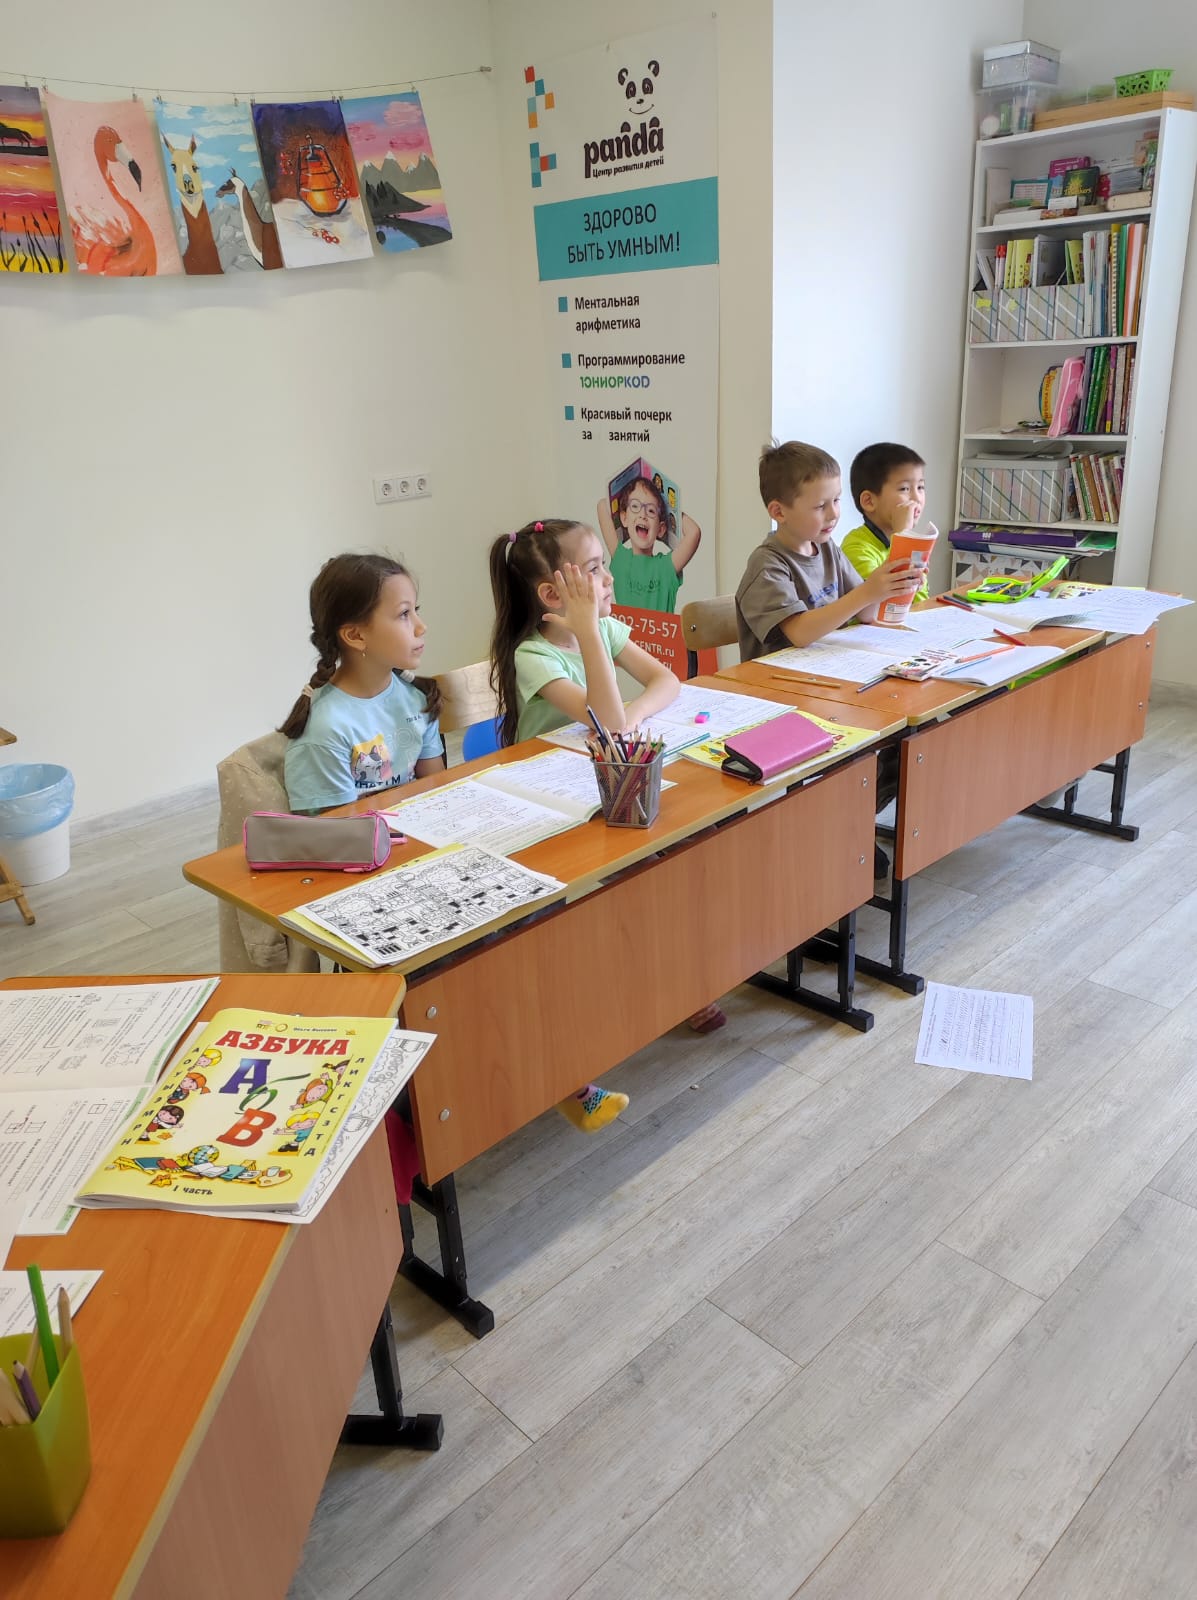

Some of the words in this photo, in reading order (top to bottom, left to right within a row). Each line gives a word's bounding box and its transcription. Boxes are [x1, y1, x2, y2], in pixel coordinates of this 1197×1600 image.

[584, 117, 664, 178] panda
[593, 168, 612, 178] Центр
[614, 162, 643, 176] развития
[645, 155, 664, 169] детей
[584, 203, 657, 234] ЗДОРОВО
[568, 242, 604, 264] БЫТЬ
[607, 231, 680, 259] УМНЫМ!
[575, 295, 640, 310] Ментальная
[576, 317, 641, 334] арифметика
[578, 352, 686, 369] Программирование
[581, 407, 631, 422] Красивый
[634, 410, 672, 424] почерк
[582, 430, 592, 440] за
[608, 429, 650, 442] занятий
[215, 1030, 349, 1055] АЗБУКА
[183, 1187, 213, 1195] часть
